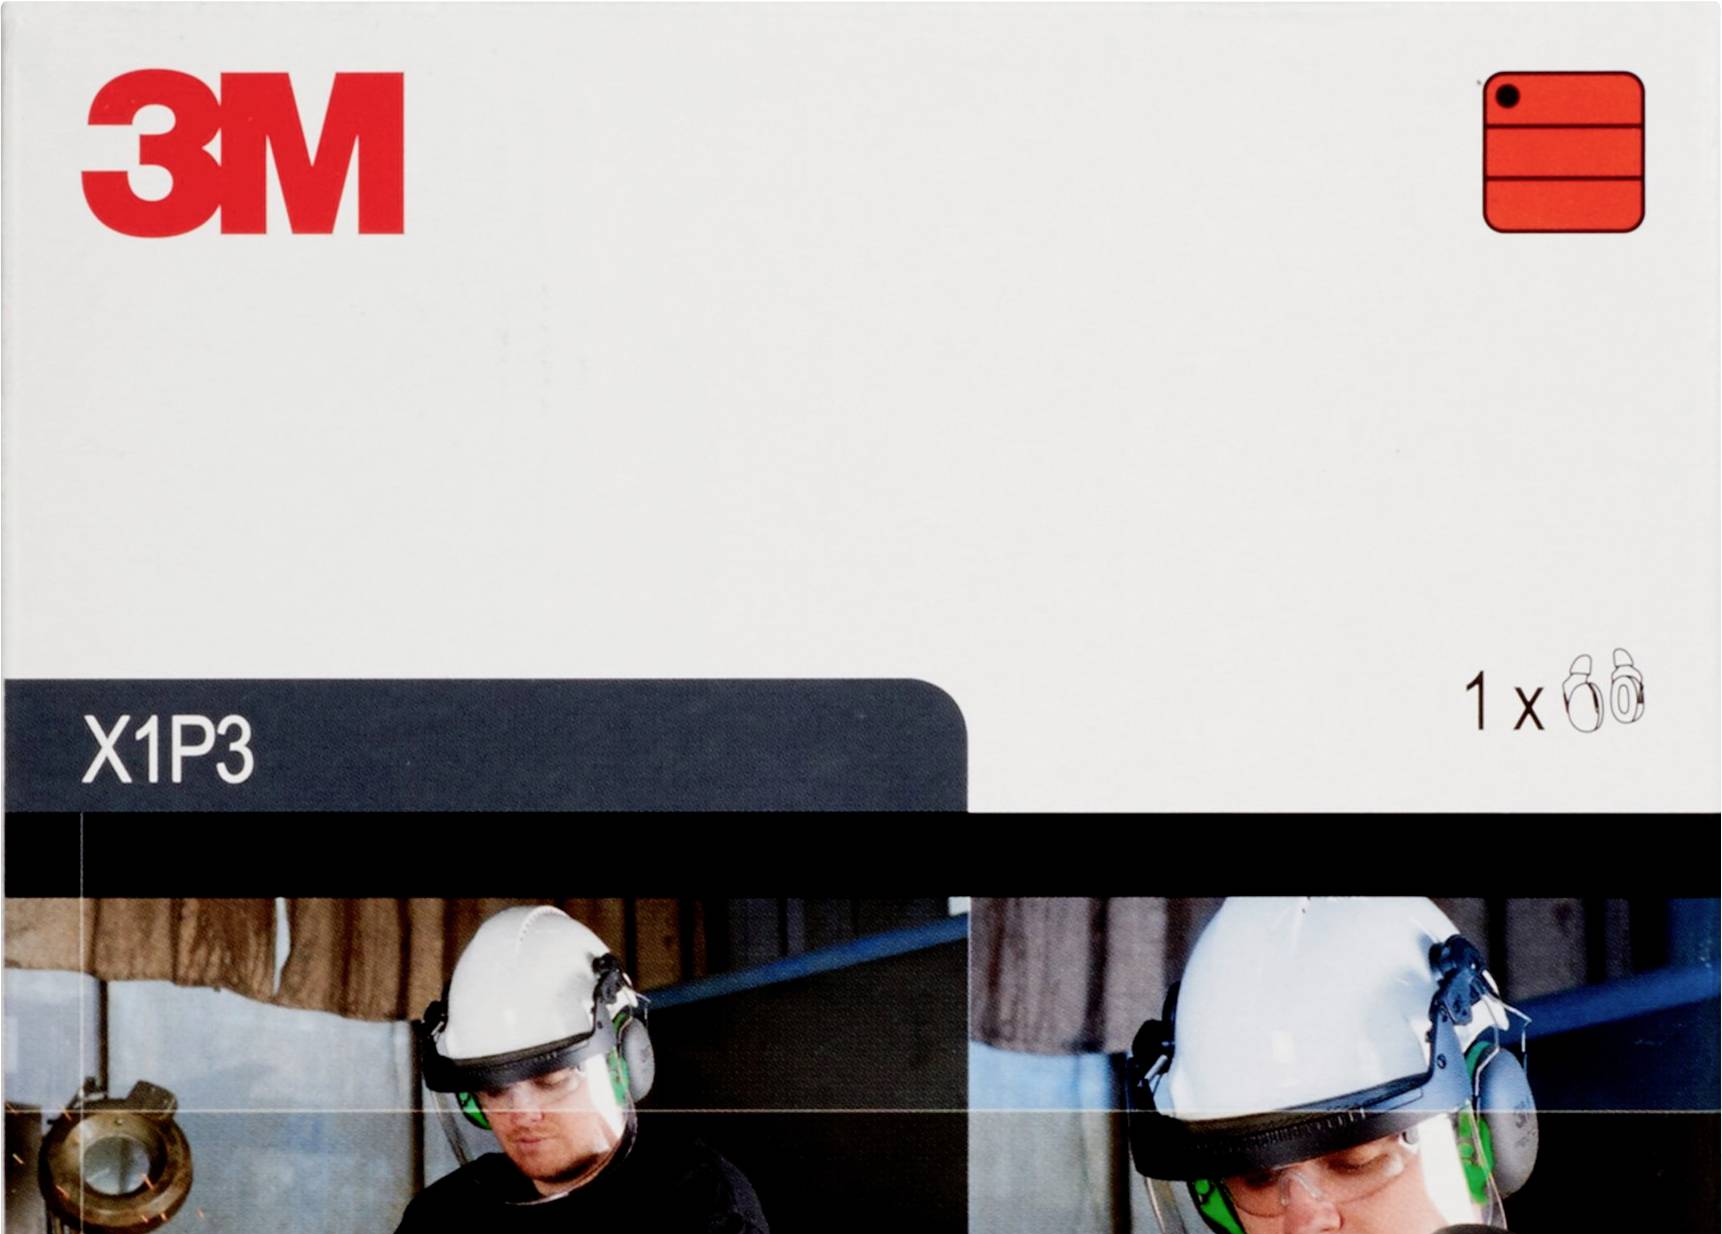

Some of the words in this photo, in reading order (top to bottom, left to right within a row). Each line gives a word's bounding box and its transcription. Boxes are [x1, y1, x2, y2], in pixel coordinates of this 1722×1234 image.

[81, 68, 405, 239] 3M
[1465, 670, 1484, 731] 1
[1513, 687, 1545, 731] x
[81, 714, 254, 785] X1P3
